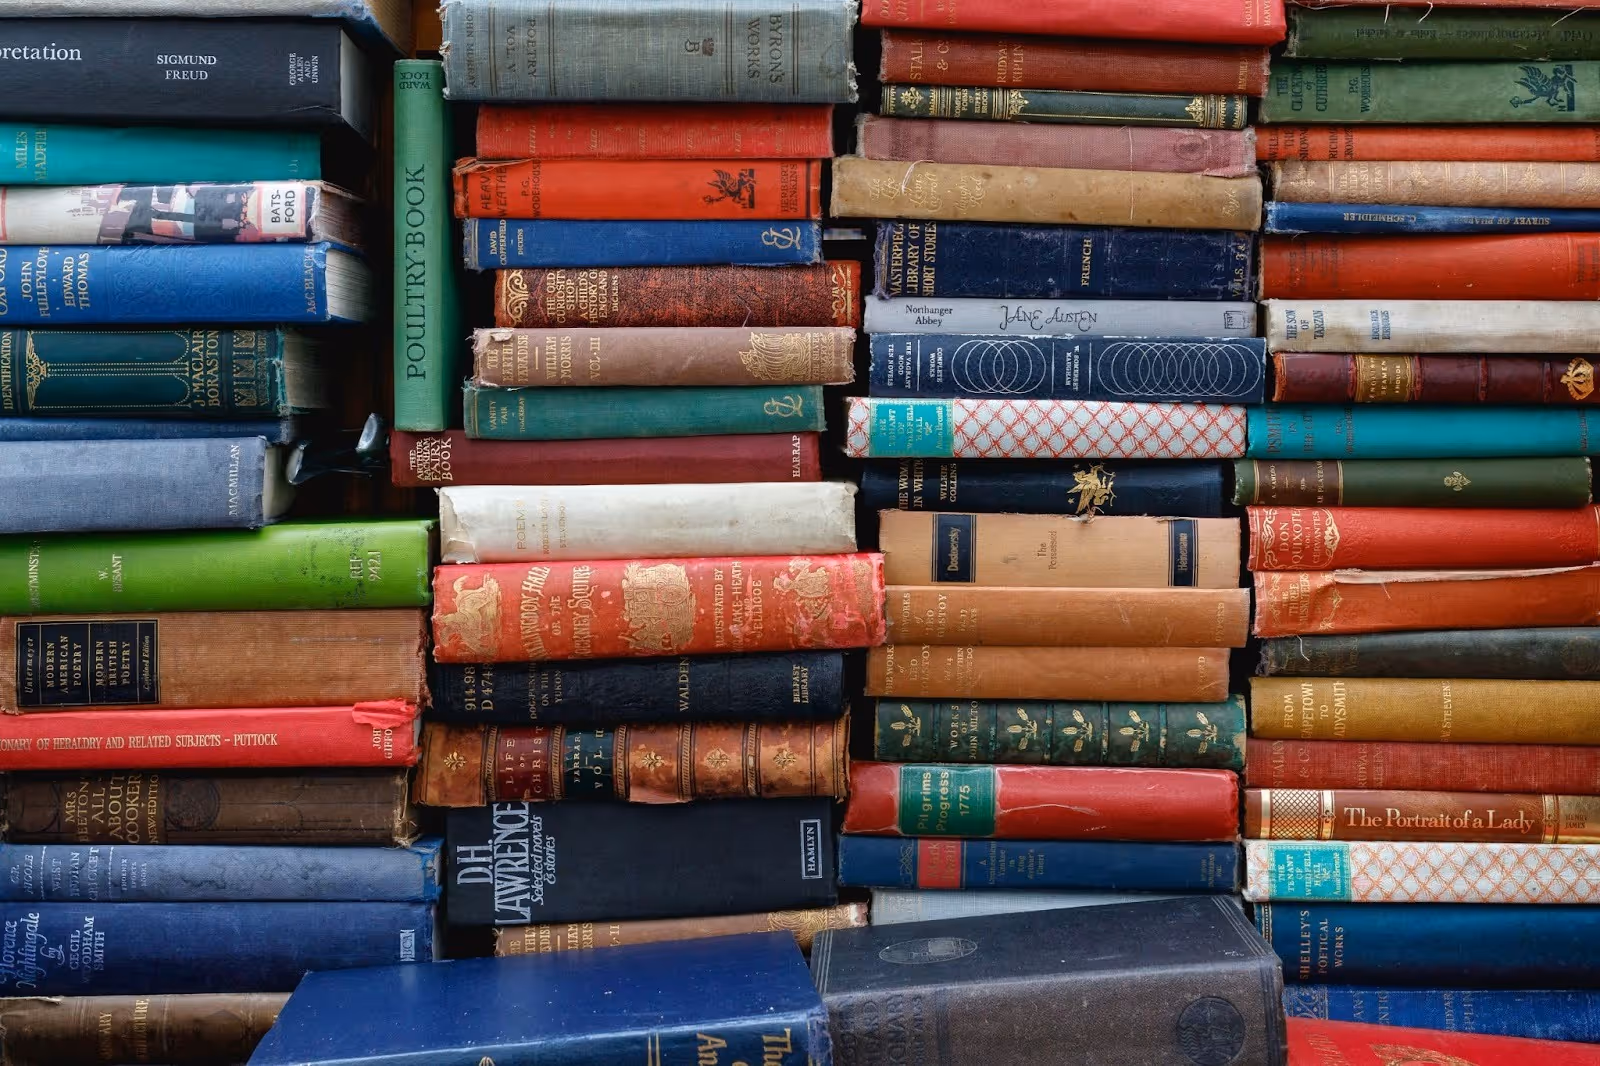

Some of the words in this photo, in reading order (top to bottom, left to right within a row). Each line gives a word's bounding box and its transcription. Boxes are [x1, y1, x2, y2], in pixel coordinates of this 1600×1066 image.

[0, 42, 82, 62] retation
[157, 54, 217, 66] SIGMUND
[527, 17, 539, 78] POETRY
[747, 17, 760, 80] WORKS
[769, 13, 784, 84] BYRON'S
[165, 70, 208, 81] FREUD
[289, 52, 297, 86] GEORGE
[311, 55, 319, 84] UNWIN
[398, 81, 431, 90] WARD
[400, 71, 430, 81] LOCK
[1278, 76, 1288, 96] THE
[16, 131, 28, 168] MILES
[271, 189, 281, 224] BATS-
[284, 190, 296, 224] FORD
[780, 163, 790, 213] HERBERT
[789, 164, 798, 213] JENKINS
[908, 223, 920, 239] OF
[1344, 212, 1405, 223] SCHMEIDLER
[1512, 216, 1551, 225] SURVEY
[924, 221, 936, 262] STORIES
[21, 261, 33, 302] JOHN
[37, 246, 51, 318] FULLEYLOVE
[62, 257, 77, 307] EDWARD
[77, 252, 91, 310] THOMAS
[907, 242, 919, 294] LIBRARY
[922, 265, 935, 296] SHORT
[1081, 239, 1092, 286] FRENCH
[547, 273, 556, 293] OLD
[556, 269, 566, 324] CURIOSITY
[566, 279, 575, 311] SHOP
[578, 271, 588, 310] CHILD'S
[589, 281, 598, 324] HISTORY
[598, 271, 609, 318] ENGLAND
[547, 296, 556, 316] THE
[905, 303, 954, 314] Northanger
[914, 314, 943, 325] Abbey
[1000, 304, 1044, 331] JANE
[1045, 306, 1098, 333] AUSTEN
[1286, 309, 1296, 324] SON
[1301, 319, 1308, 330] OF
[1313, 310, 1324, 339] TARZAN
[812, 333, 820, 360] SILVER
[1286, 325, 1296, 339] THE
[1, 331, 13, 410] IDENTIFICATION
[206, 330, 220, 407] BORASTON
[487, 349, 499, 370] THE
[517, 334, 528, 382] PARADISE
[546, 336, 557, 380] WILLIAM
[560, 335, 572, 379] MORRIS
[1064, 352, 1072, 386] MAUGHAM
[489, 400, 497, 430] VANITY
[416, 441, 424, 480] ARTHUR
[423, 438, 432, 481] RACKHAM
[431, 437, 442, 481] FAIRY
[441, 437, 453, 481] BOOK
[792, 434, 800, 477] HARRAP
[229, 444, 241, 517] MACMILLAN
[948, 463, 957, 502] COLLINS
[948, 528, 961, 572] Dostoevsky
[1037, 542, 1047, 558] The
[1048, 531, 1057, 571] Possessed
[1178, 533, 1188, 571] Heinemann
[1279, 522, 1289, 552] DON
[1292, 510, 1303, 564] QUIXOTE
[1311, 511, 1321, 563] CERVANTES
[521, 566, 551, 598] HALL
[714, 568, 724, 581] BY
[551, 621, 561, 636] OR
[714, 584, 725, 648] ILLUSTRATED
[25, 636, 36, 694] Untermeyer
[46, 641, 56, 689] MODERN
[59, 635, 70, 695] AMERICAN
[73, 642, 83, 686] POETRY
[95, 640, 105, 687] MODERN
[108, 640, 118, 687] BRITISH
[121, 640, 132, 685] POETRY
[142, 634, 152, 658] Edition
[463, 666, 476, 711] 914.98
[554, 670, 563, 703] YUKON
[679, 657, 689, 712] WALDEN
[792, 664, 800, 703] BELFAST
[800, 666, 809, 704] LIBRARY
[950, 705, 959, 748] WORKS
[961, 721, 967, 733] OF
[1283, 694, 1293, 729] FROM
[1320, 704, 1328, 720] TO
[0, 738, 32, 751] ONARY
[36, 738, 50, 750] OF
[52, 737, 102, 750] HERALDRY
[105, 736, 124, 749] AND
[128, 736, 171, 749] RELATED
[175, 735, 220, 748] SUBJECTS
[232, 733, 277, 747] PUTTOCK
[505, 739, 515, 784] LIFE
[532, 726, 544, 794] CHRIST
[970, 734, 978, 760] JOHN
[65, 791, 77, 823] MRS
[91, 787, 105, 824] ALL
[108, 774, 125, 840] ABOUT
[125, 773, 142, 844] COOKER
[917, 772, 935, 830] Pilgrims
[936, 771, 952, 832] Progress
[959, 785, 970, 816] 1775
[1344, 806, 1382, 827] The
[1385, 808, 1451, 828] Portrait
[1487, 809, 1535, 835] Lady
[530, 815, 542, 854] novels
[806, 826, 816, 873] HAMLYN
[51, 858, 62, 892] WEST
[70, 851, 81, 897] INDIAN
[88, 846, 100, 901] CRICKET
[457, 839, 493, 885] D.H.
[493, 801, 531, 925] LAWRENCE
[531, 854, 544, 906] Selected
[1286, 855, 1295, 893] TENANT
[1295, 868, 1302, 880] OF
[1304, 850, 1312, 897] WILDFELL
[1313, 862, 1321, 886] HALL
[16, 912, 48, 988] Nightingale
[70, 929, 81, 970] CECIL
[82, 916, 95, 984] WOODHAM
[94, 930, 105, 970] SMITH
[402, 932, 413, 958] BCA
[1300, 910, 1310, 979] SHELLEY'S
[1318, 918, 1328, 975] POETICAL
[1334, 926, 1344, 968] WORKS
